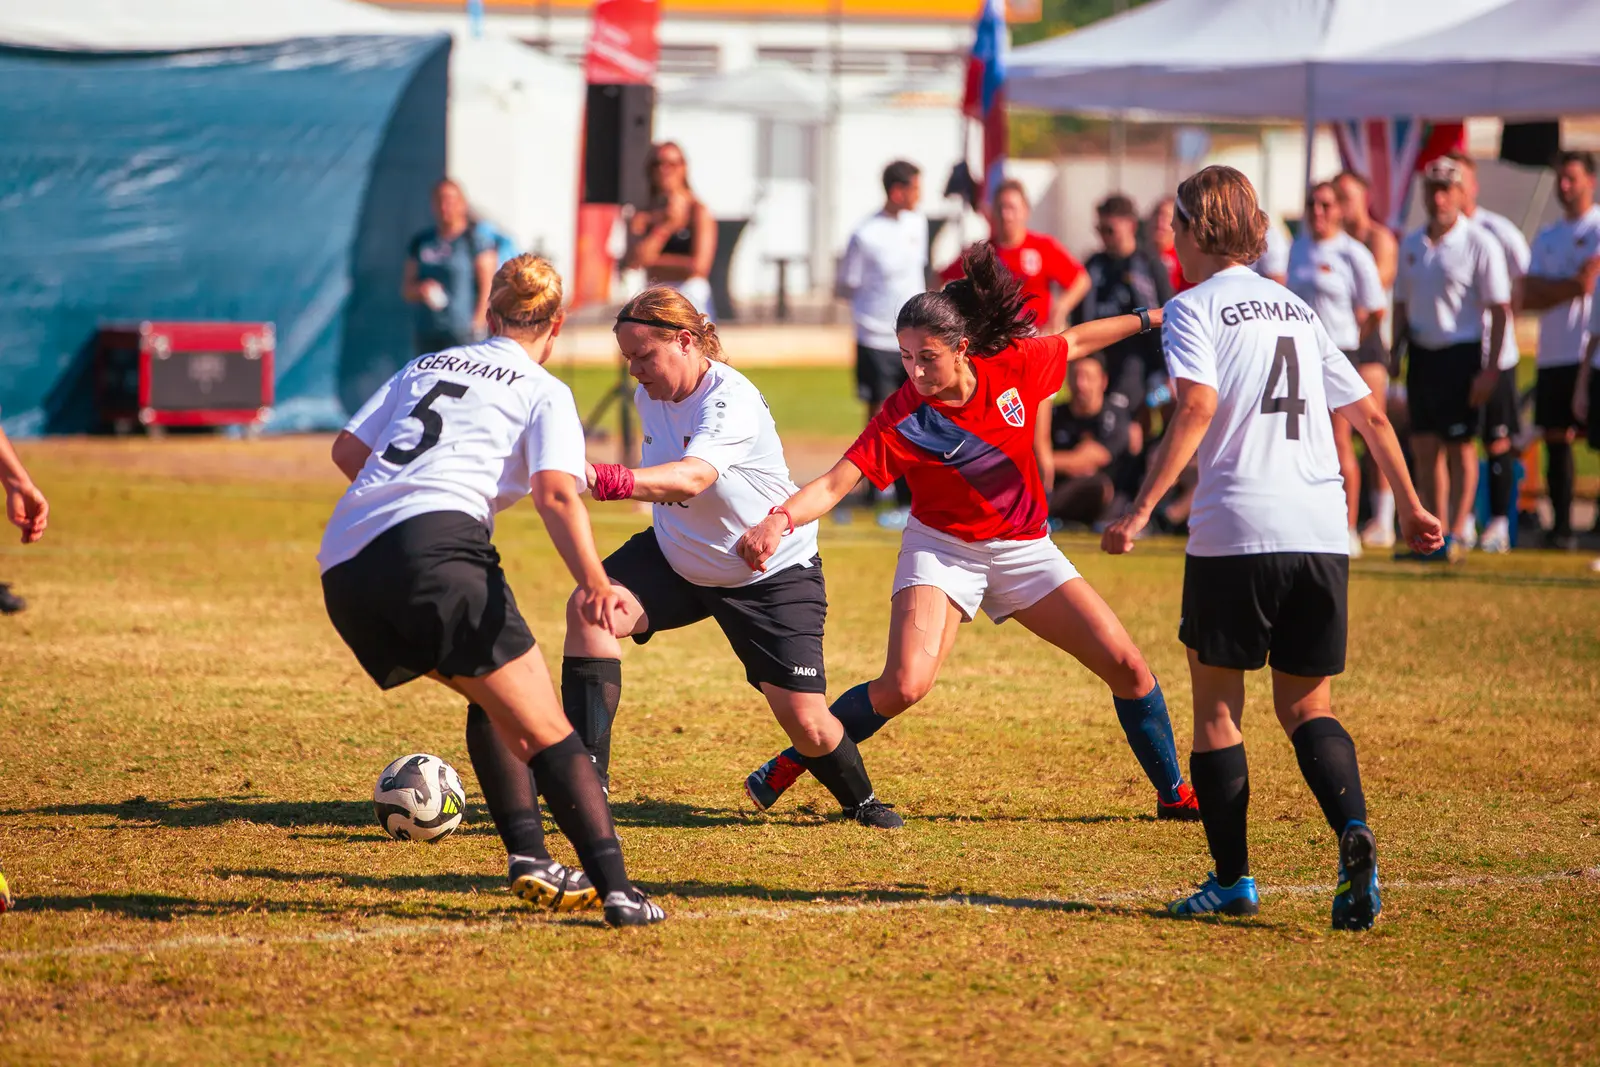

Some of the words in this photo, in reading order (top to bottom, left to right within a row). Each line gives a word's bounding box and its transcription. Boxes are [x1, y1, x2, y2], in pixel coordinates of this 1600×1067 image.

[1220, 300, 1315, 326] GERMAN
[416, 354, 525, 386] GERMANY
[1260, 335, 1306, 441] 4
[380, 379, 470, 465] 5
[792, 666, 817, 677] JAKO
